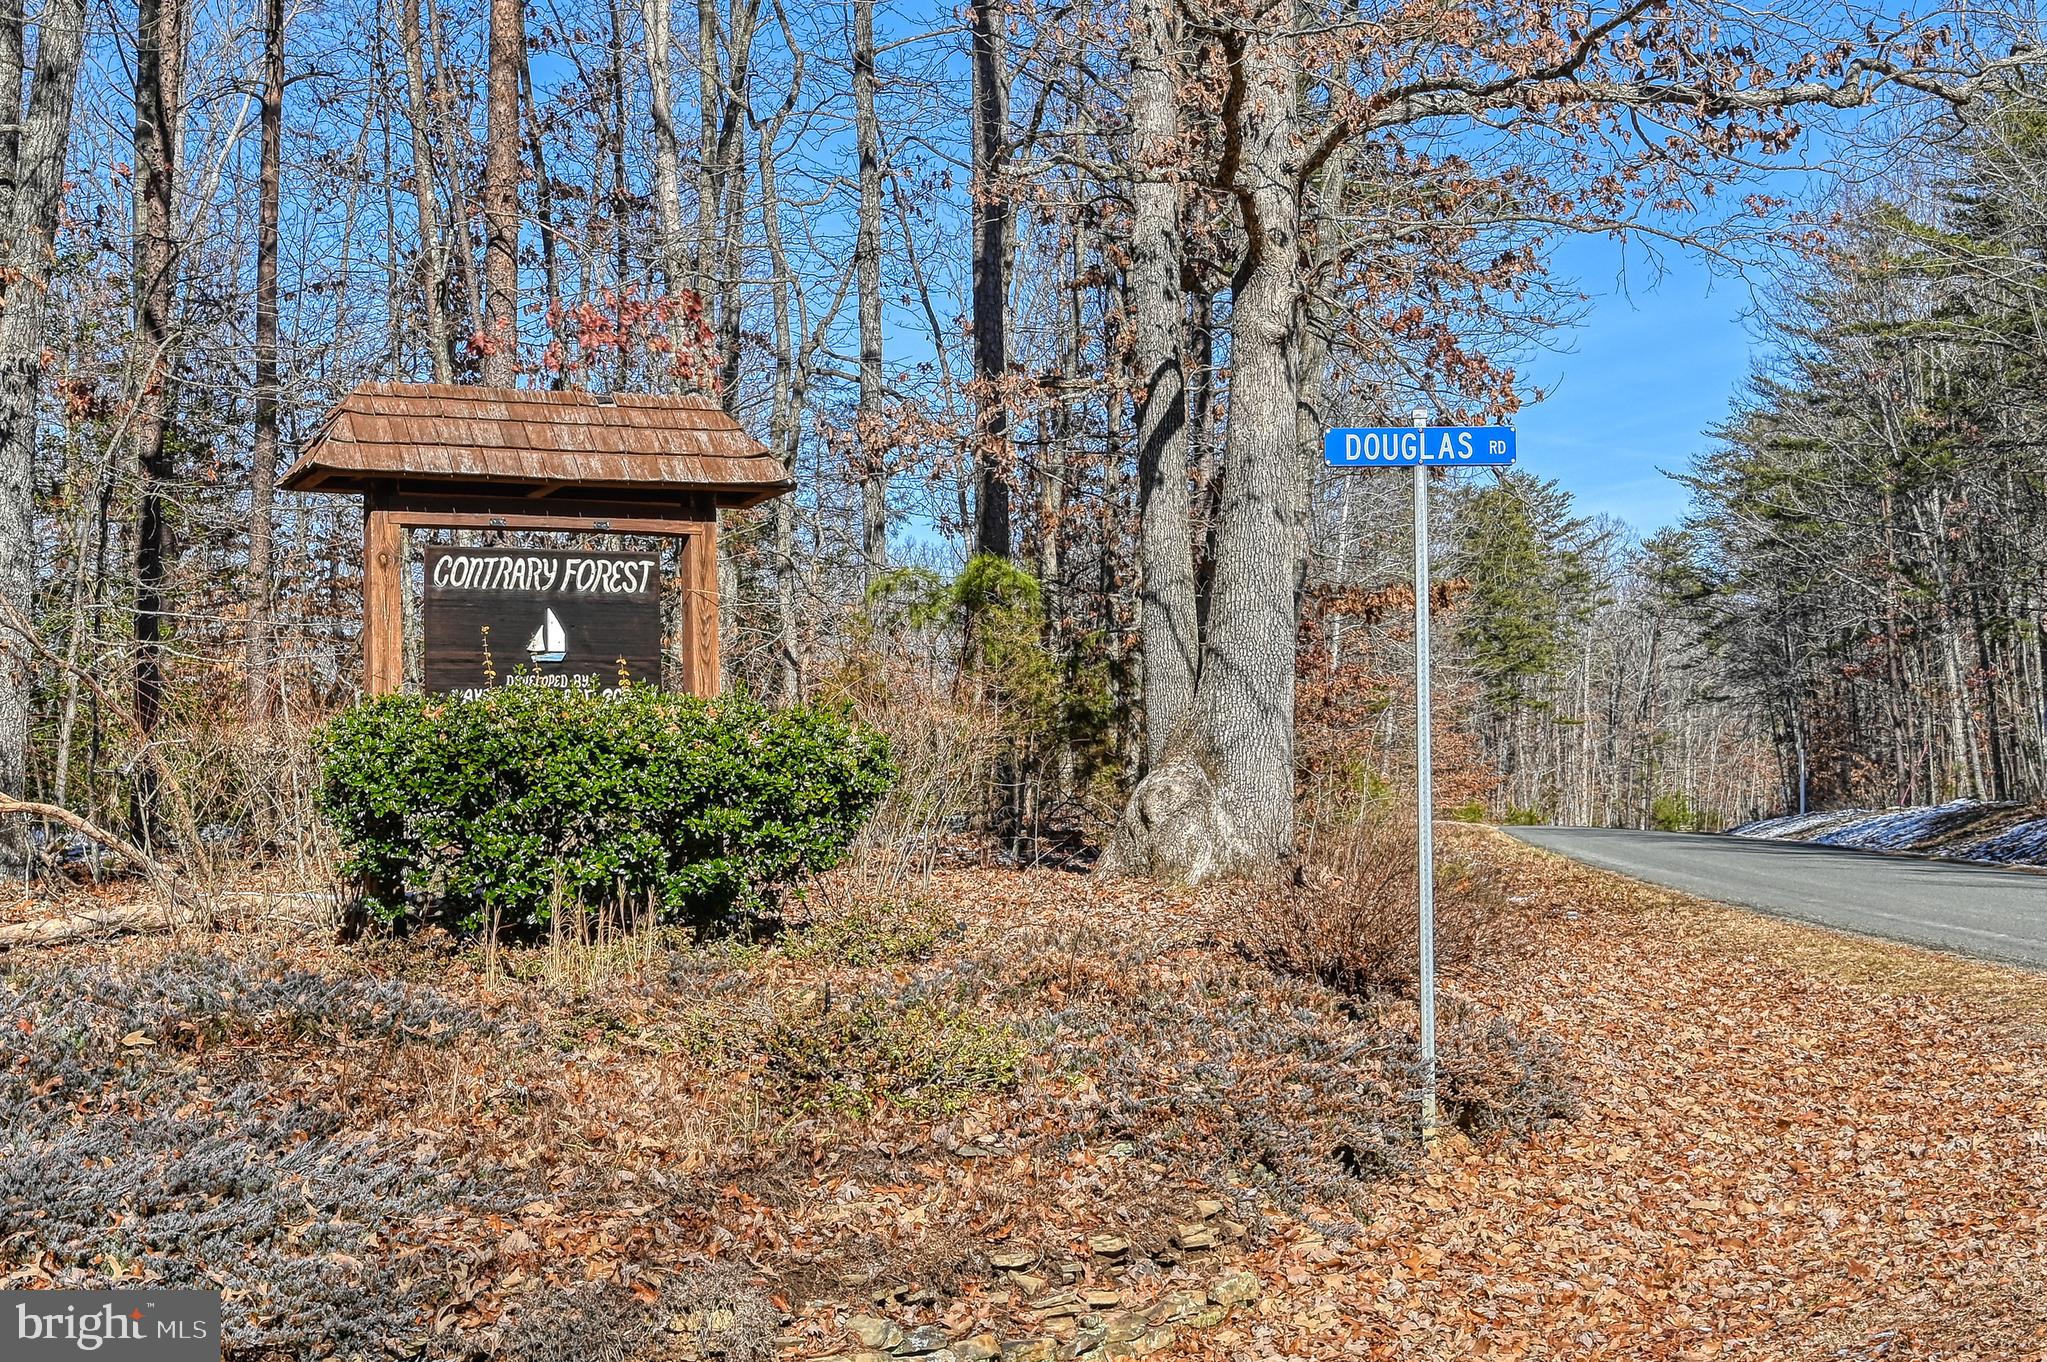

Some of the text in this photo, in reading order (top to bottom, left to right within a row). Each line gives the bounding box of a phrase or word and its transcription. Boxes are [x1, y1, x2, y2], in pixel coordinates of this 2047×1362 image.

[1345, 432, 1506, 460] DOUGLAS RD
[433, 555, 655, 593] CONTRARY FOREST
